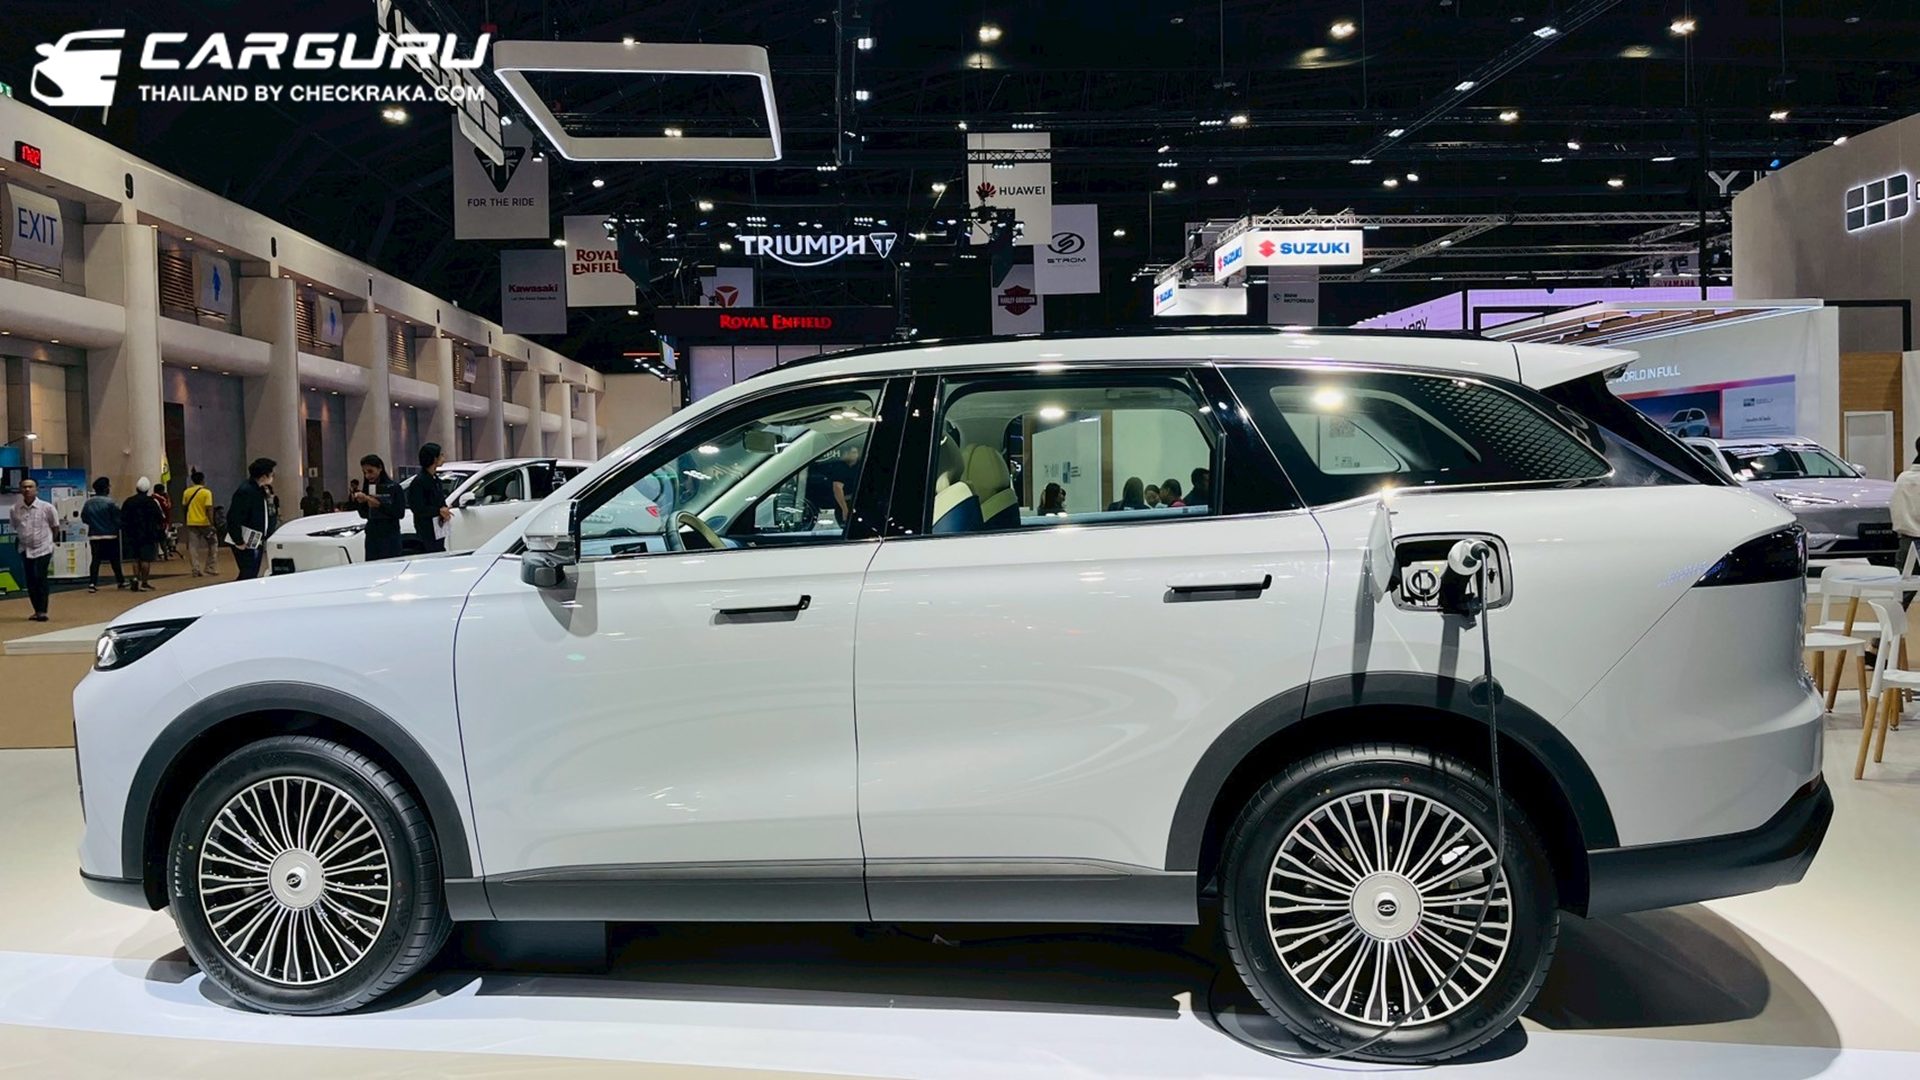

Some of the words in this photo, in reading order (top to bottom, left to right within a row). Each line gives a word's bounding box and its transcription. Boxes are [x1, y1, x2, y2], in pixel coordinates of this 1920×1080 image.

[999, 186, 1046, 196] HUAWEI
[467, 198, 487, 207] FOR
[489, 198, 509, 207] THE
[512, 197, 535, 207] RIDE
[18, 207, 57, 246] EXIT
[735, 234, 866, 266] TRIUMPH
[1280, 242, 1350, 254] SUZUKI
[572, 262, 626, 275] ENFIEL
[509, 284, 558, 293] Kawasaki
[720, 315, 768, 329] ROYAL
[772, 314, 832, 330] ENFIELD
[1657, 365, 1681, 377] FULL
